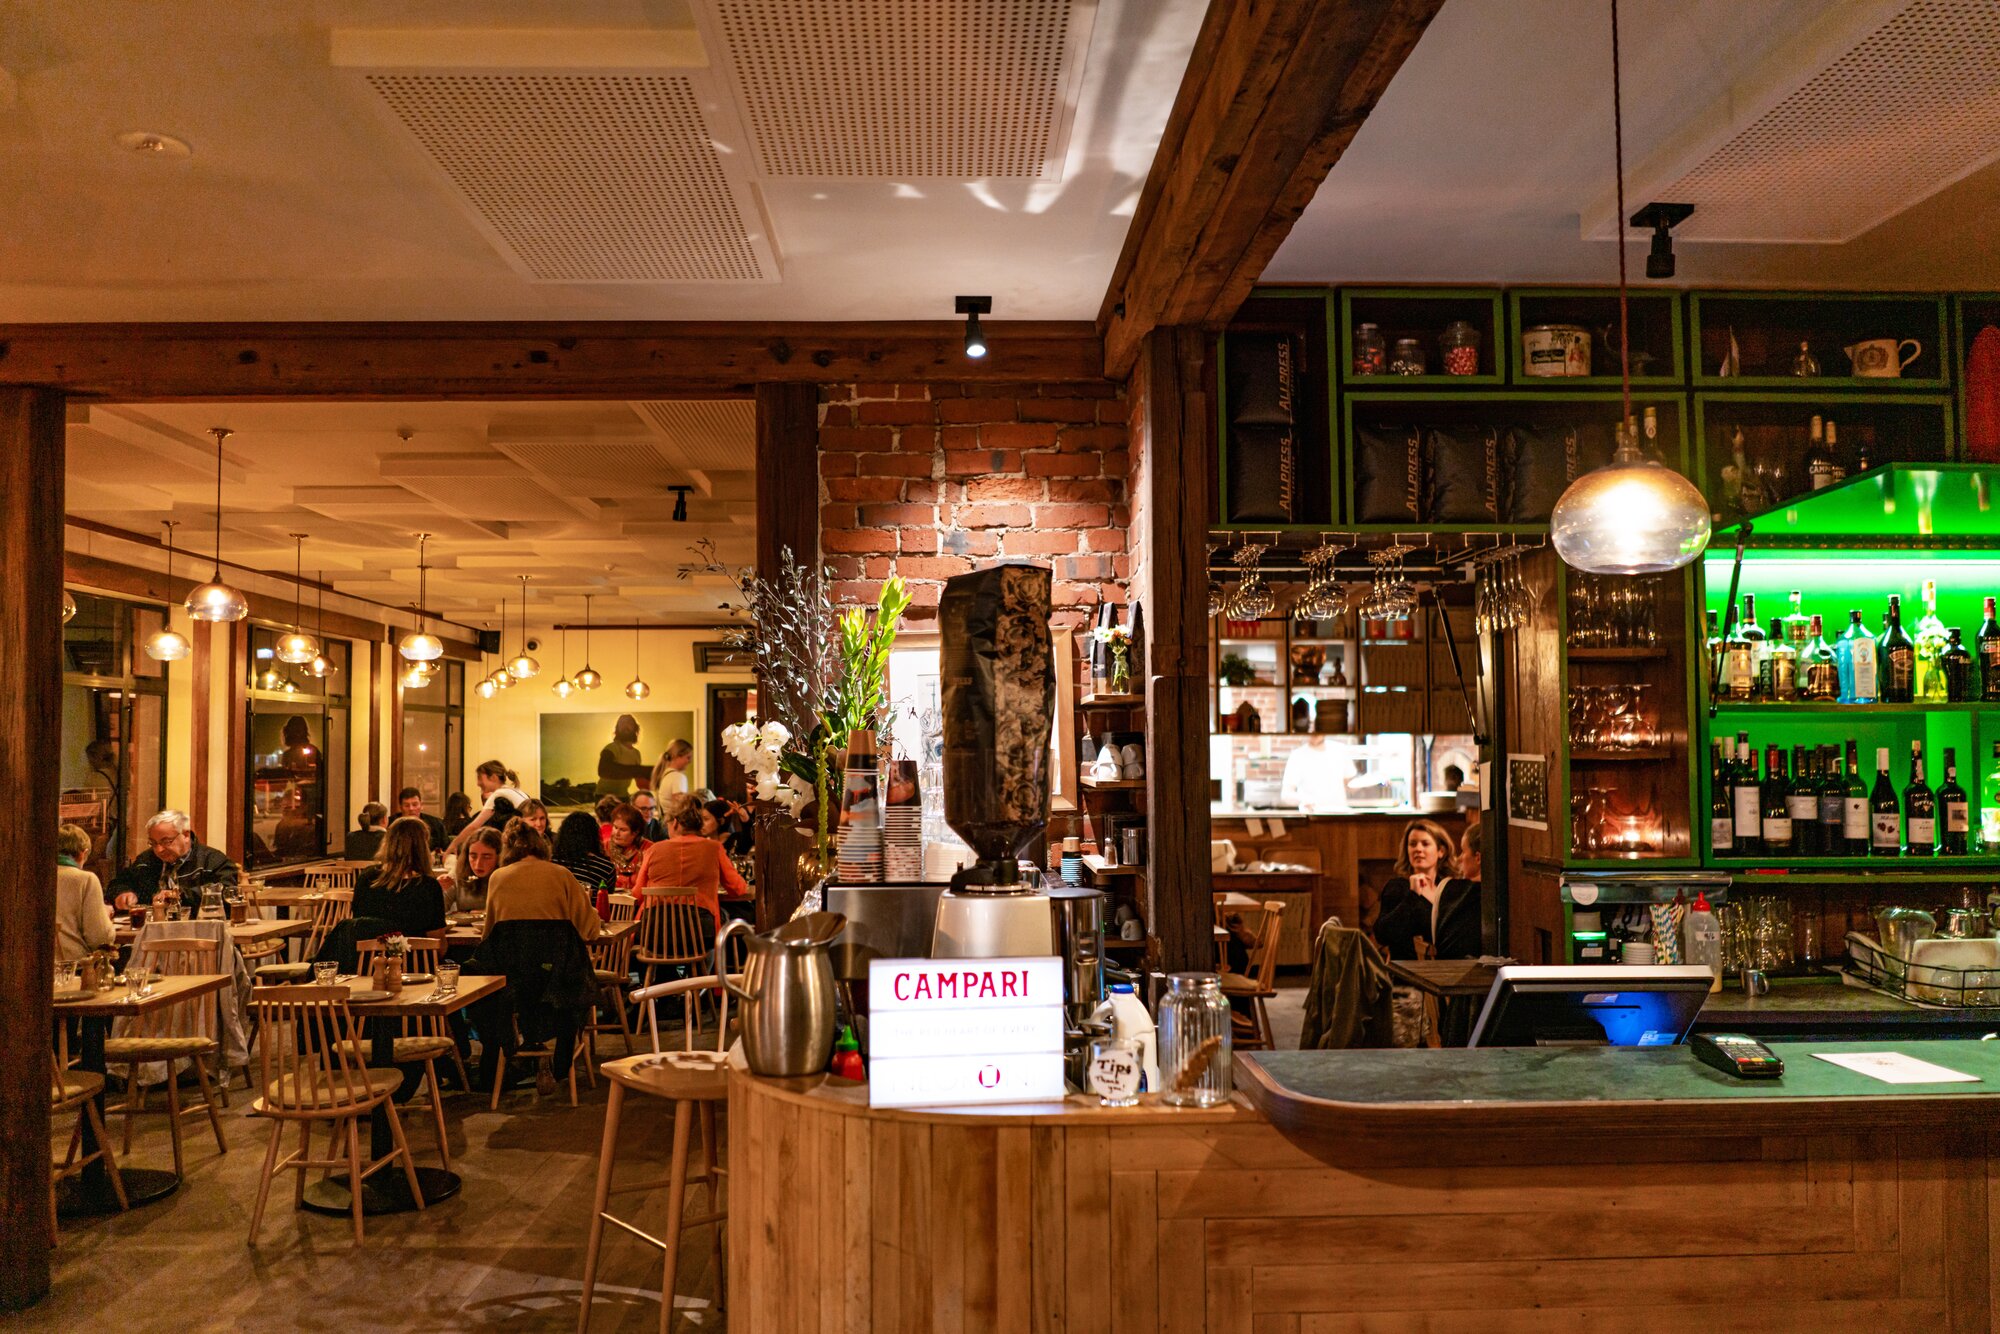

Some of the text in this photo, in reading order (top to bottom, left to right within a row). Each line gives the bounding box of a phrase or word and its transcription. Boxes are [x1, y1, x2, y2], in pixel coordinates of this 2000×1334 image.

[1277, 342, 1290, 411] ALLPRESS
[1278, 437, 1291, 512] ALLPRESS
[1406, 438, 1418, 512] ALLPRESS
[1485, 438, 1497, 512] ALLPRESS
[1565, 436, 1576, 482] PRESS
[894, 970, 1029, 1001] CAMPARI
[1097, 1059, 1131, 1079] Tips
